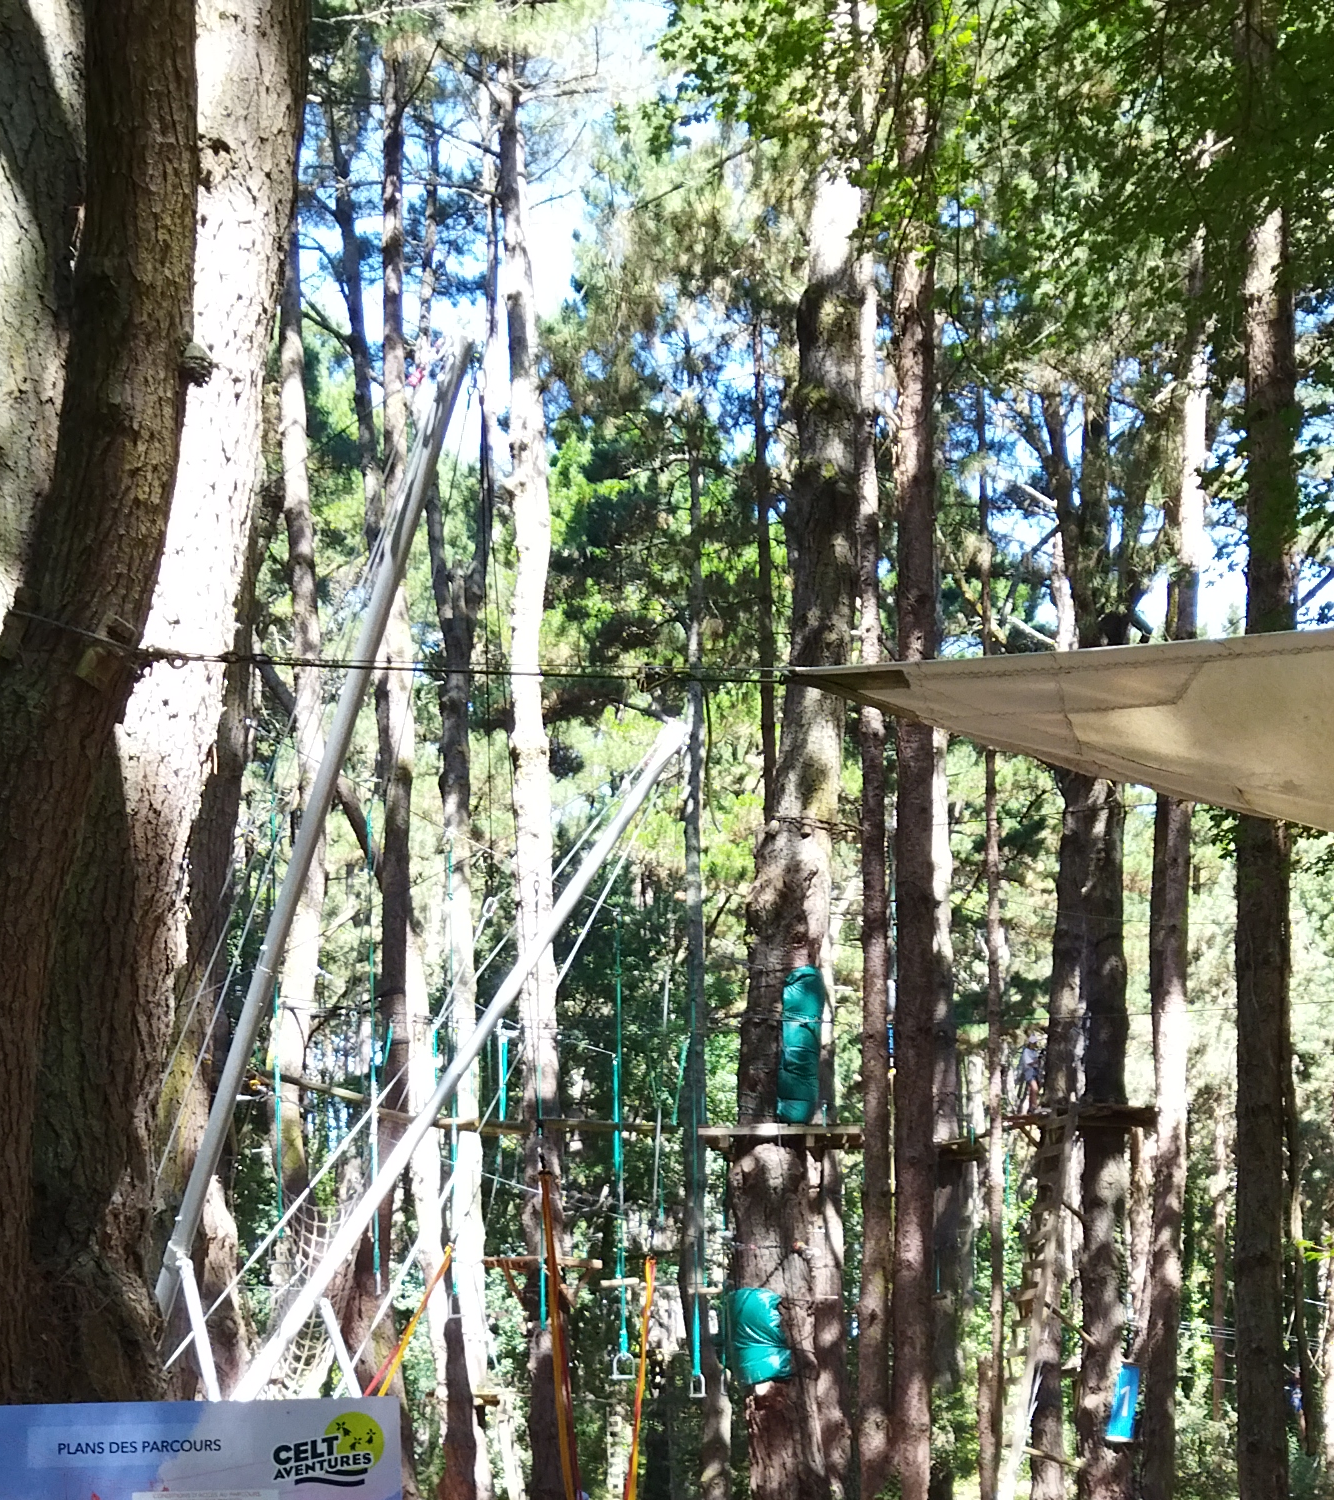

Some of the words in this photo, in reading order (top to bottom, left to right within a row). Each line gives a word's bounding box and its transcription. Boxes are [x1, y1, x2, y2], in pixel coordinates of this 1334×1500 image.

[1120, 1385, 1131, 1417] 1
[57, 1442, 105, 1455] PLANS
[109, 1441, 137, 1454] DES
[141, 1439, 222, 1453] PARCOURS
[273, 1435, 339, 1466] CELT
[273, 1452, 372, 1481] AVENTURES
